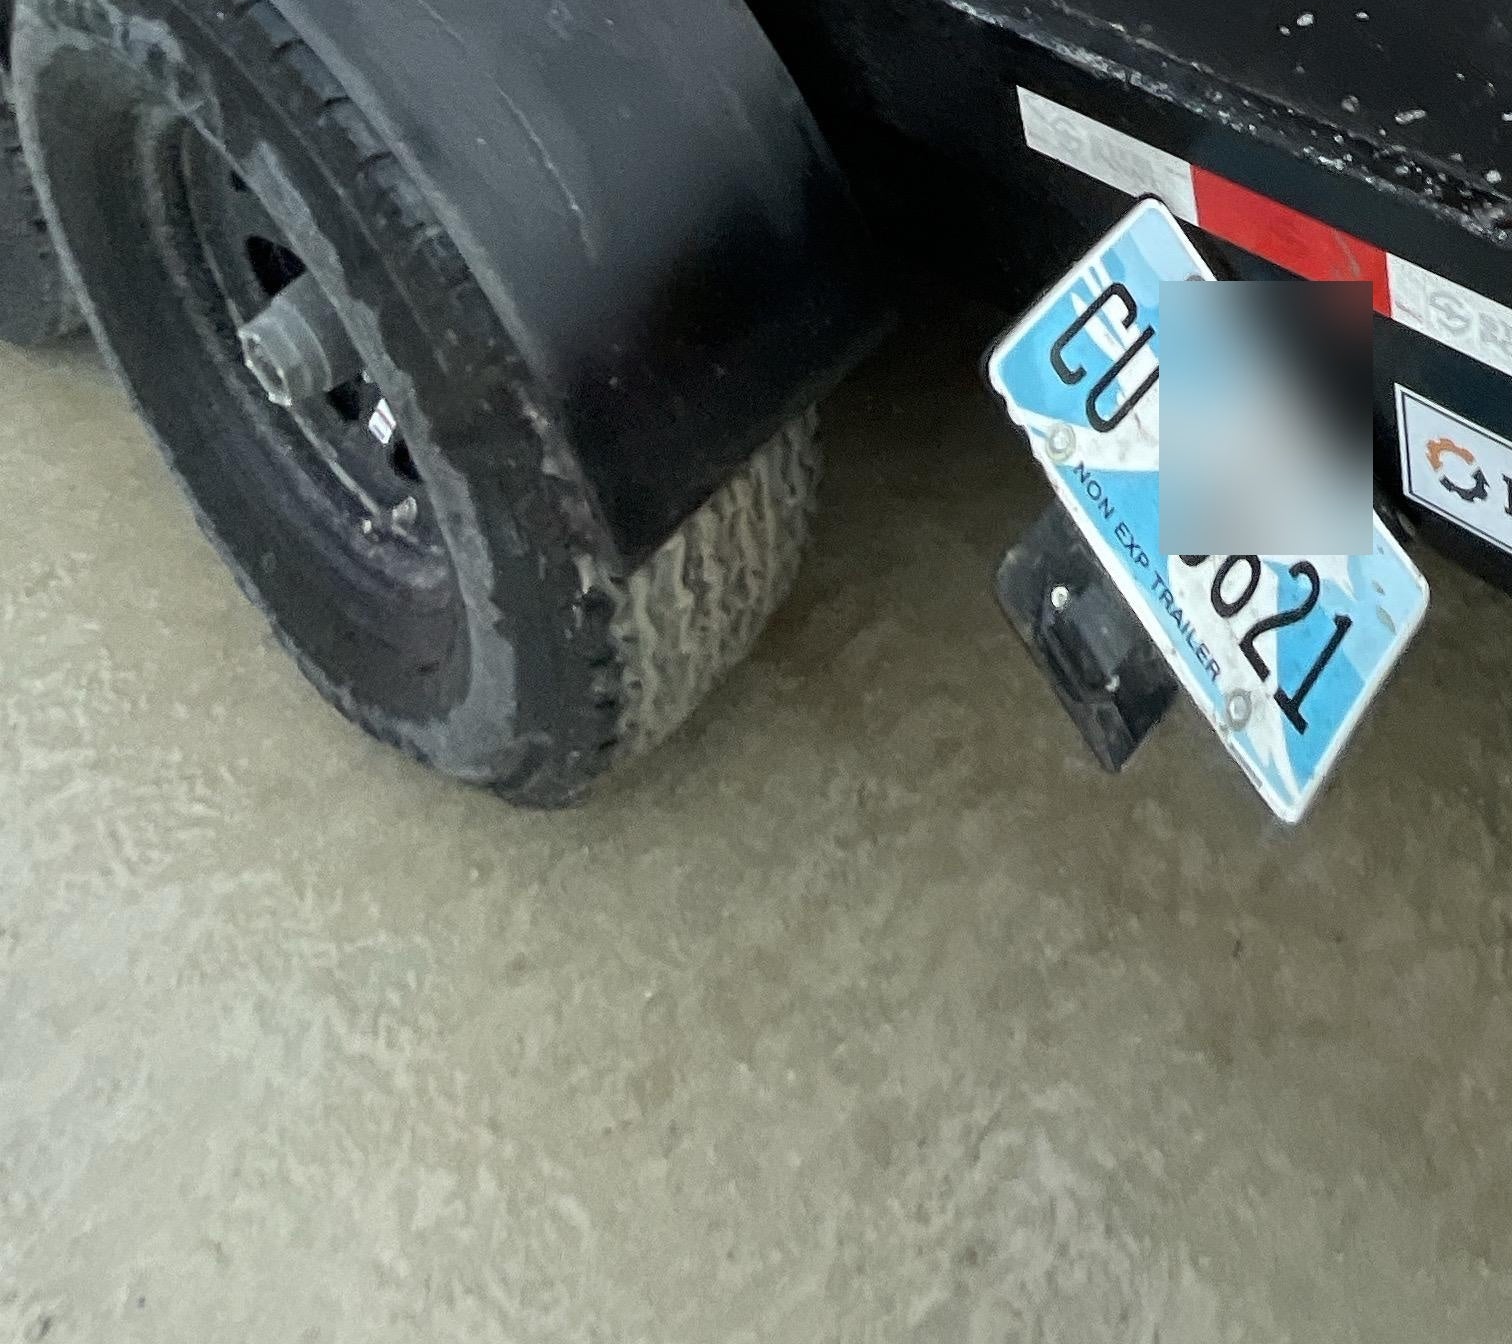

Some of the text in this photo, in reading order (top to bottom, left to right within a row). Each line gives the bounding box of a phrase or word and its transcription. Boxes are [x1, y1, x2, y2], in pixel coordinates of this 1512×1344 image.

[1073, 460, 1221, 681] NON EXP TRAILER
